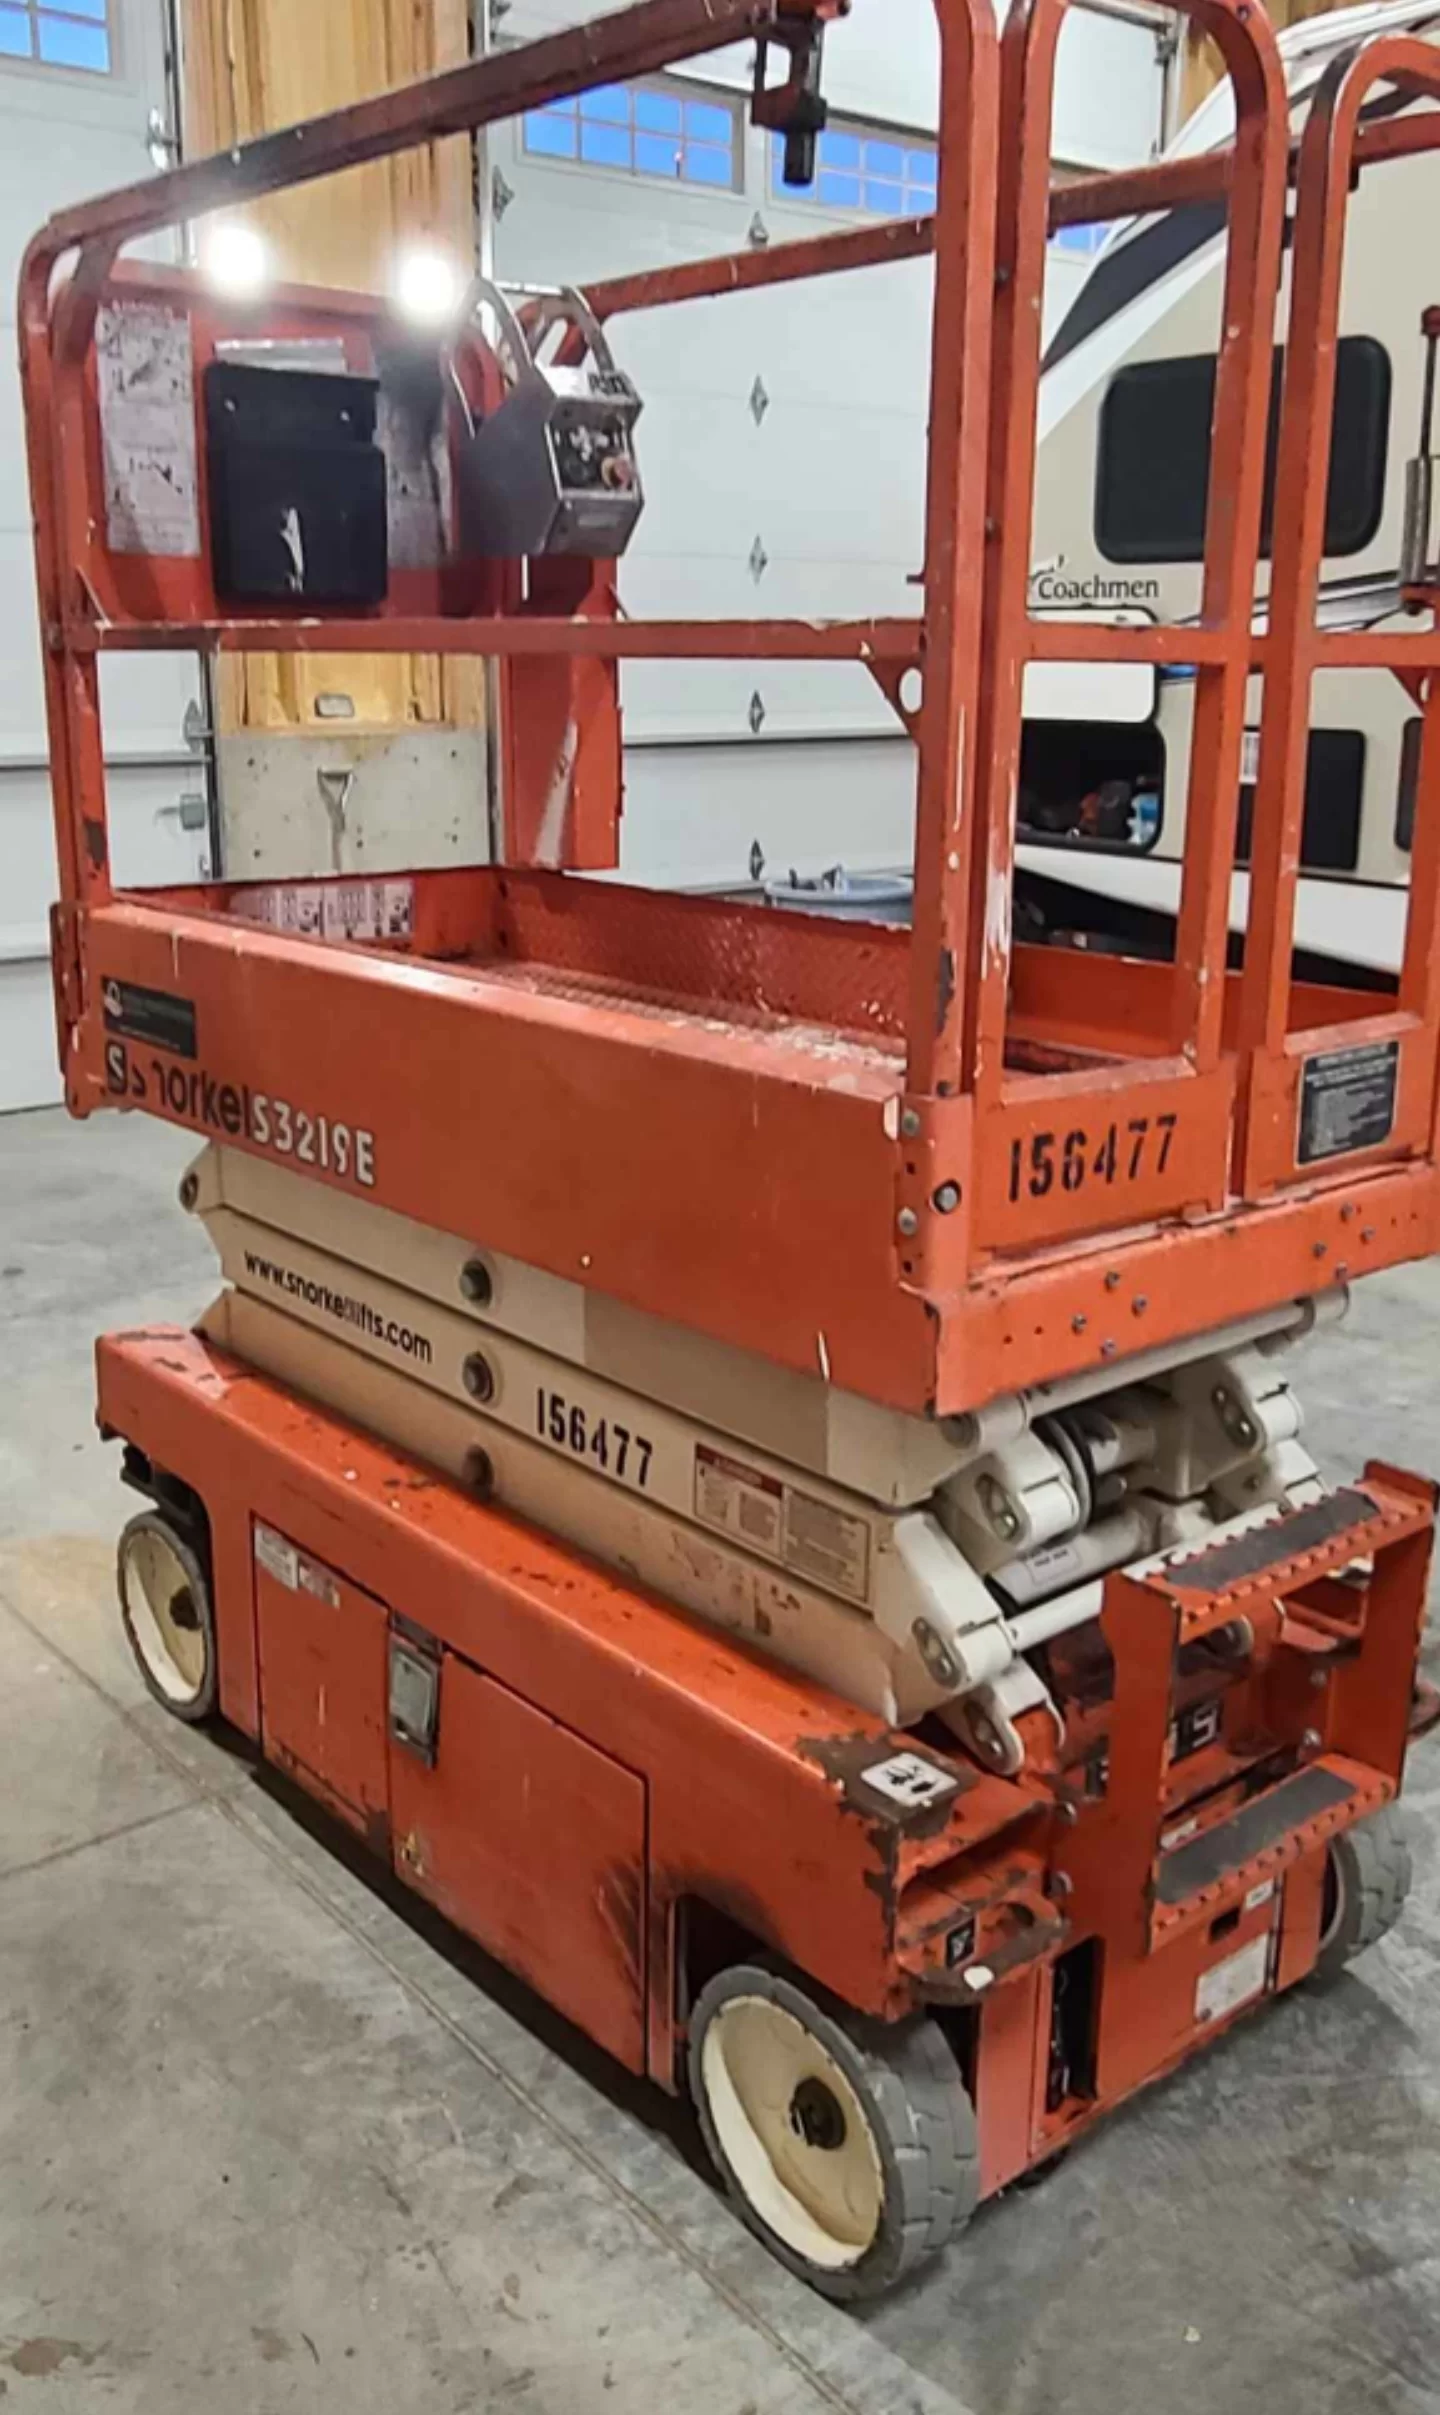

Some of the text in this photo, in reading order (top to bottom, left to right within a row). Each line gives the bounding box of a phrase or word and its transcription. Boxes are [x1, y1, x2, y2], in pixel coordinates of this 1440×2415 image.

[1038, 575, 1159, 600] Coachmen
[252, 1094, 375, 1187] S3219E
[1009, 1113, 1178, 1204] 156477
[537, 1386, 653, 1488] 156477
